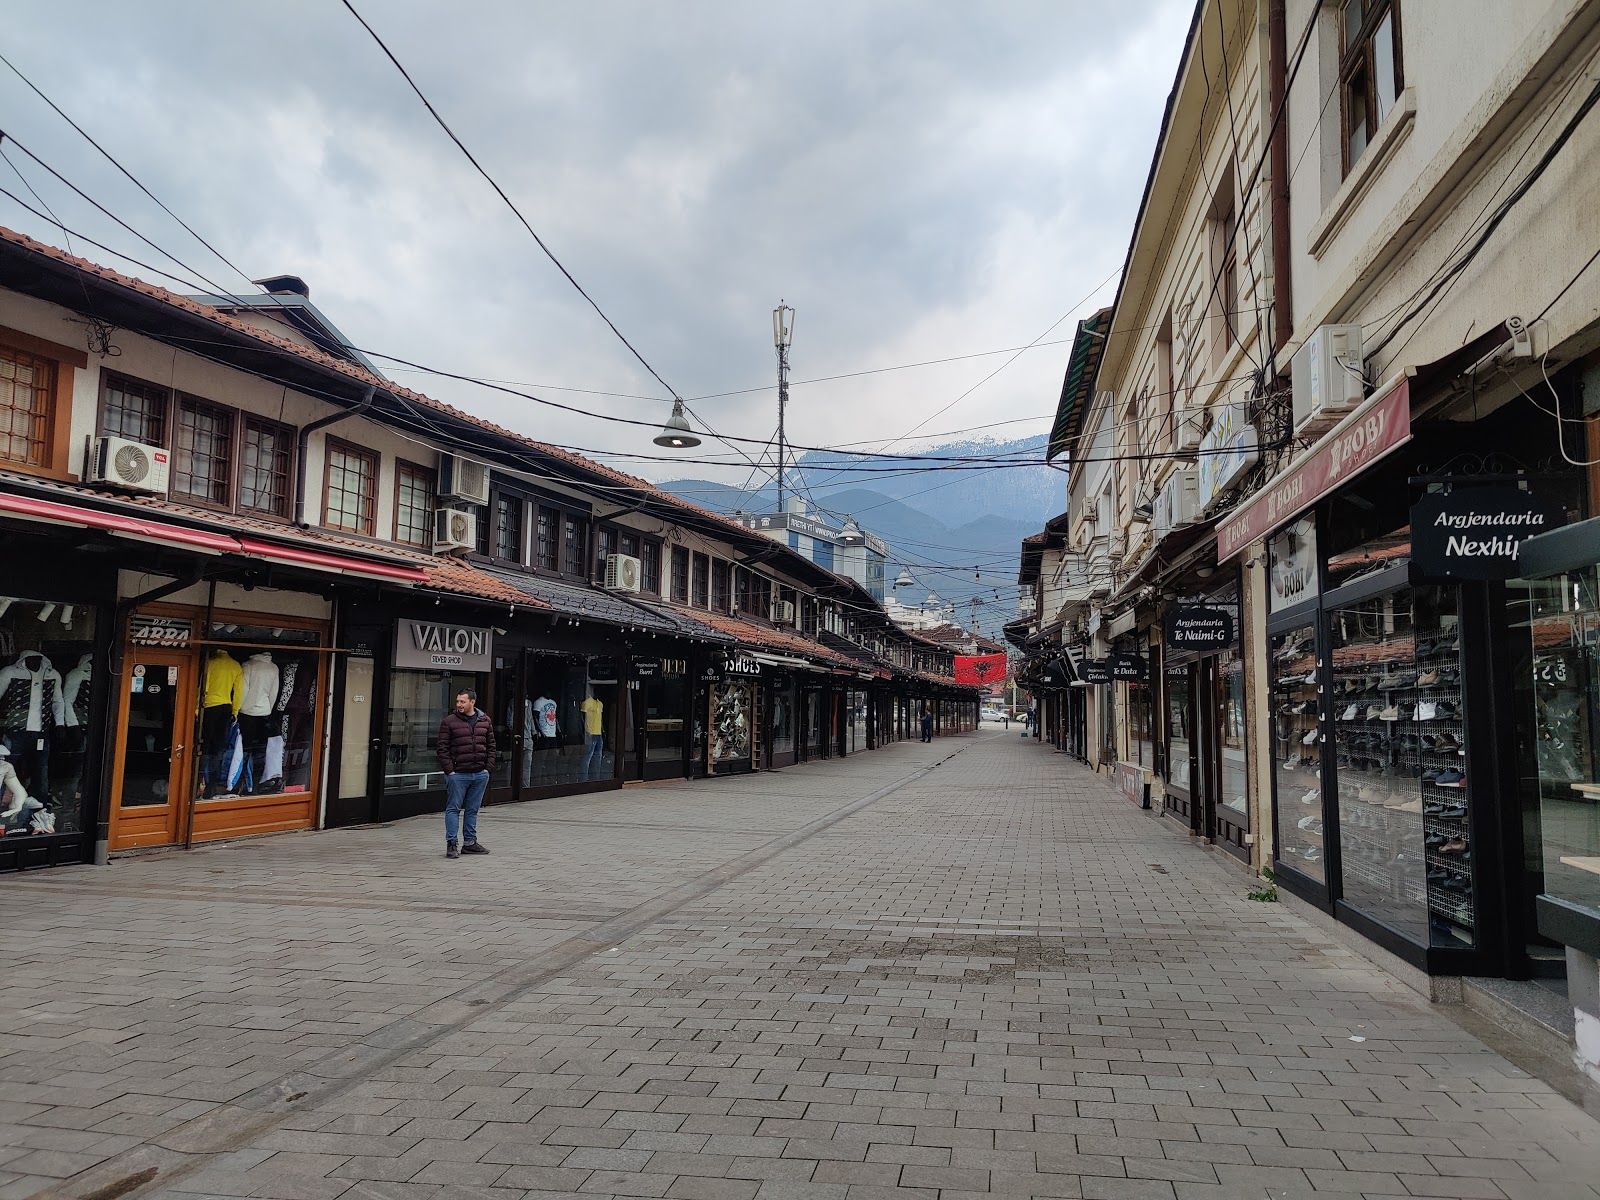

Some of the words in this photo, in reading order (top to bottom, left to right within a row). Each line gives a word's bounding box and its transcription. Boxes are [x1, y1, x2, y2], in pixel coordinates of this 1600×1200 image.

[1341, 408, 1385, 462] BOBI
[1276, 473, 1303, 511] BOBI
[1231, 515, 1250, 543] BOBI
[1434, 510, 1545, 529] Argjendaria
[1283, 568, 1305, 598] BOBI
[1174, 630, 1184, 641] Te
[1184, 629, 1225, 641] Naimi-G
[1175, 619, 1223, 628] Argjendaria
[131, 625, 189, 648] ABBA
[415, 624, 489, 655] VALONI
[1113, 667, 1120, 675] Te
